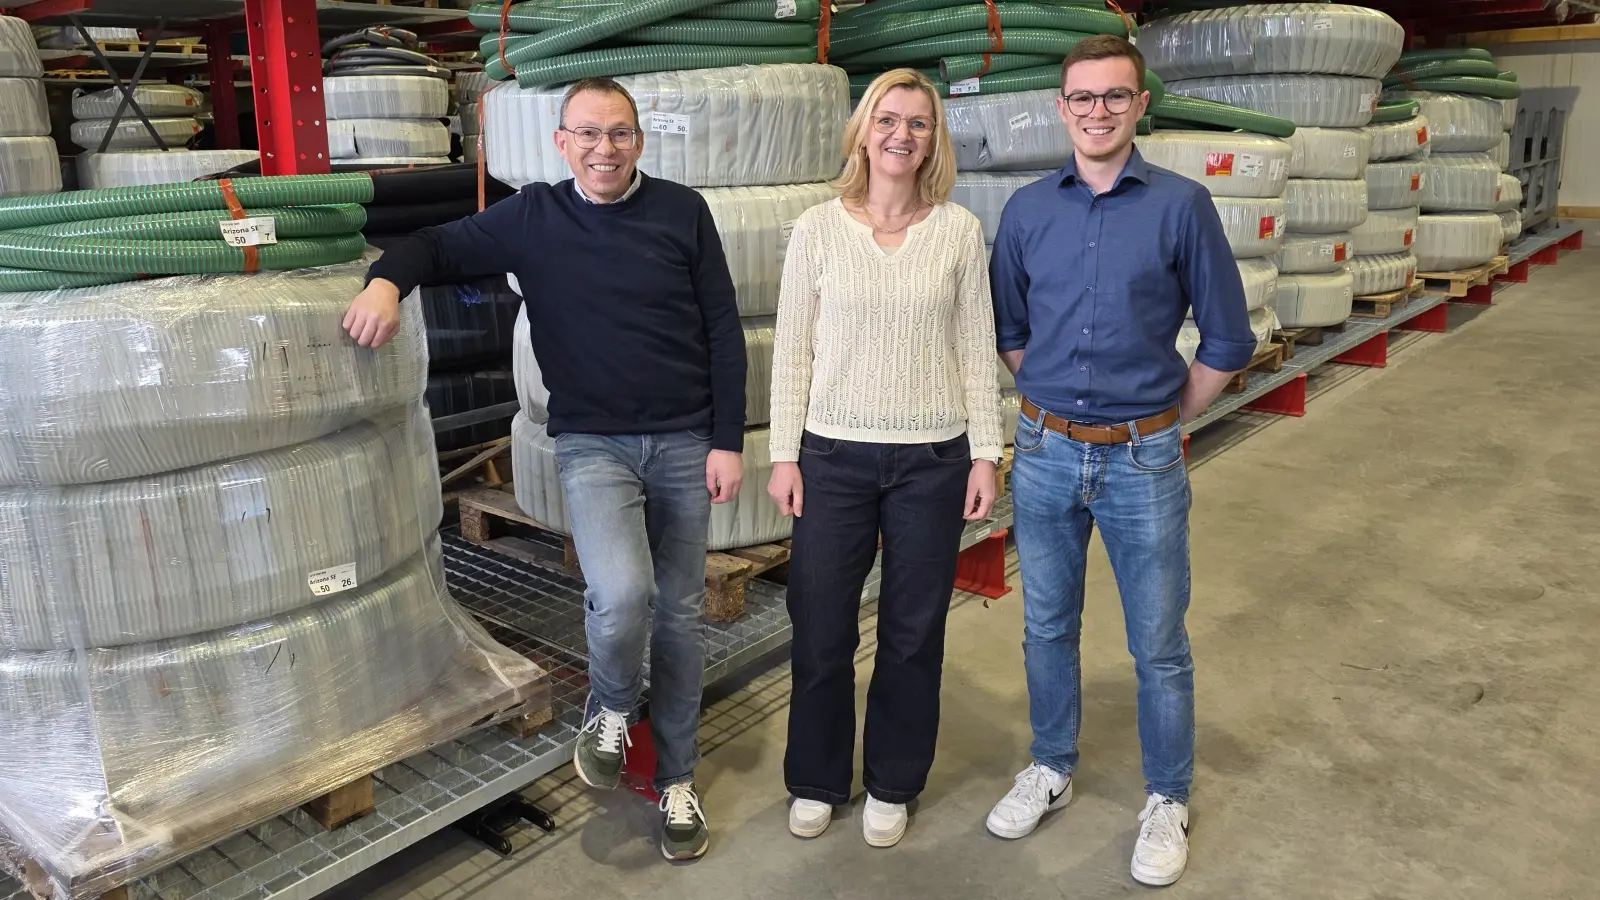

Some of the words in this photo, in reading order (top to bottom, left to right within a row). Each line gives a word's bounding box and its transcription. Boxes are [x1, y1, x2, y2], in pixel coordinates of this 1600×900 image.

[222, 227, 250, 235] Arizona
[310, 577, 329, 585] Arizona
[342, 578, 352, 587] 26
